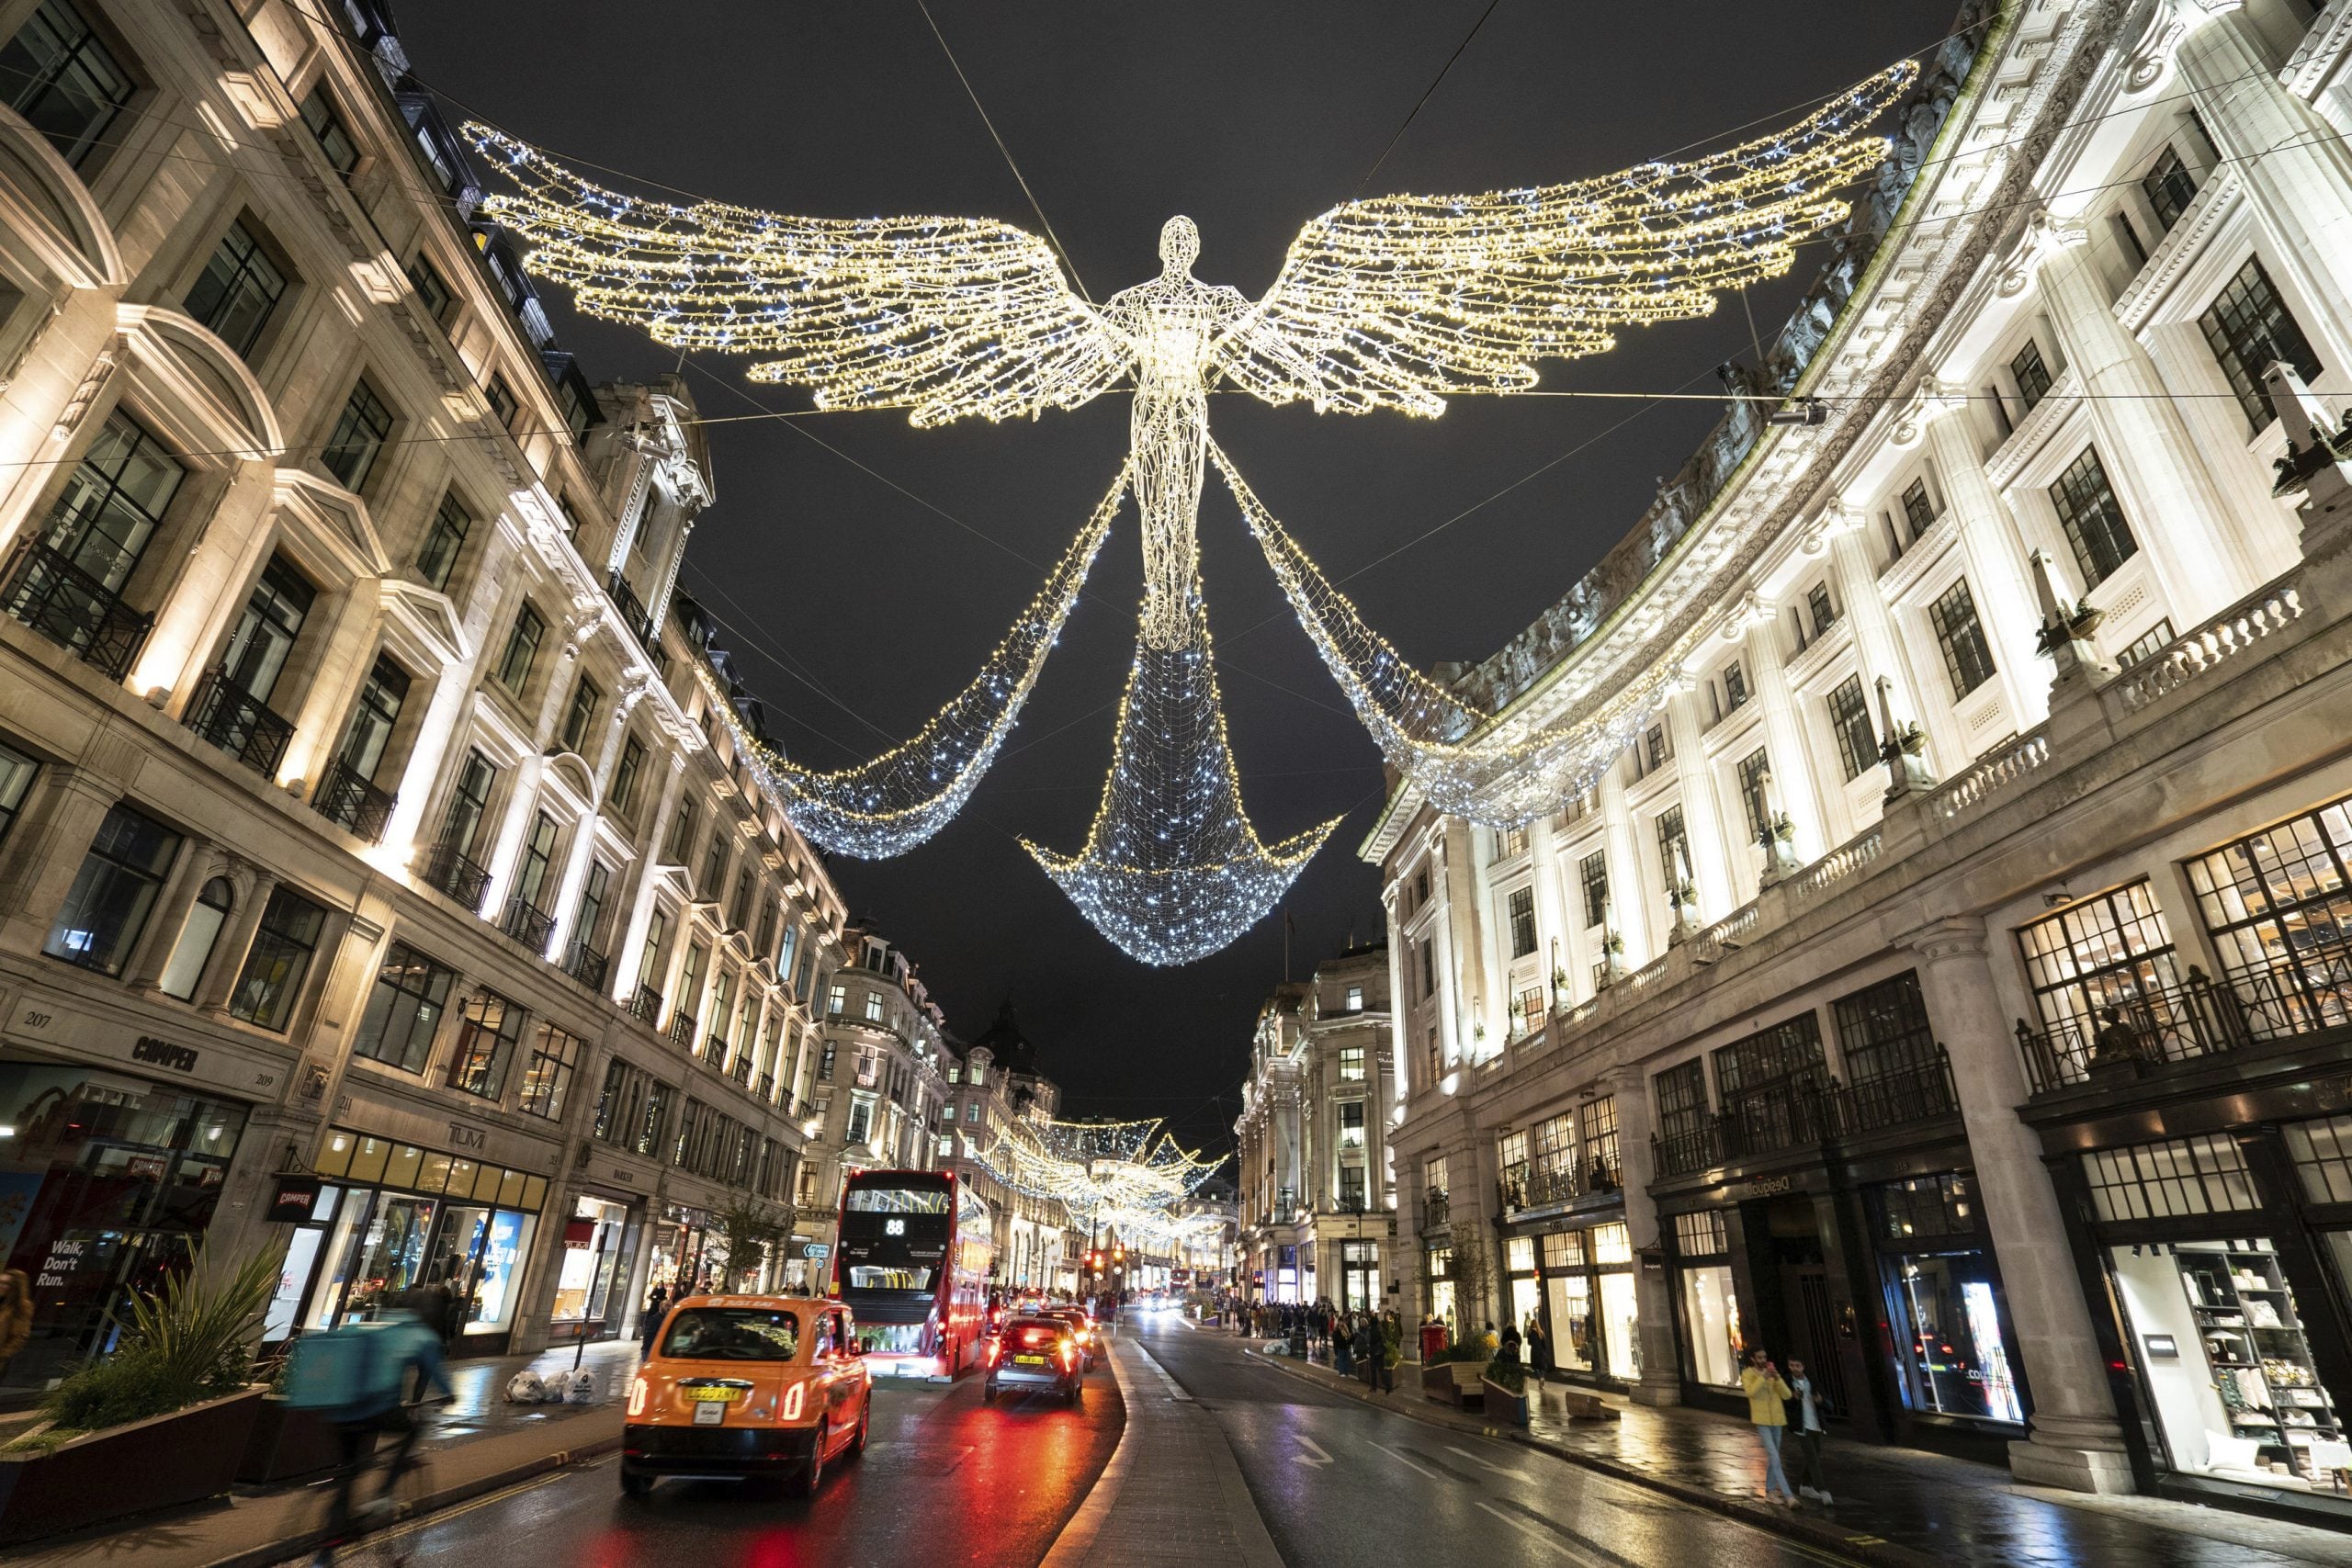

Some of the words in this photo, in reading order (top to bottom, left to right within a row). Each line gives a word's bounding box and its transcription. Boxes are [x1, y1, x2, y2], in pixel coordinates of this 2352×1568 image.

[24, 1011, 51, 1029] 207
[131, 1036, 199, 1073] CAMPER
[255, 1074, 274, 1088] 209
[338, 1095, 353, 1112] 211
[131, 1160, 164, 1178] CAMPER
[279, 1192, 311, 1206] CAMPER
[886, 1219, 905, 1235] 88
[51, 1240, 84, 1257] Walk,
[42, 1257, 78, 1270] Don't
[37, 1273, 64, 1286] Run.
